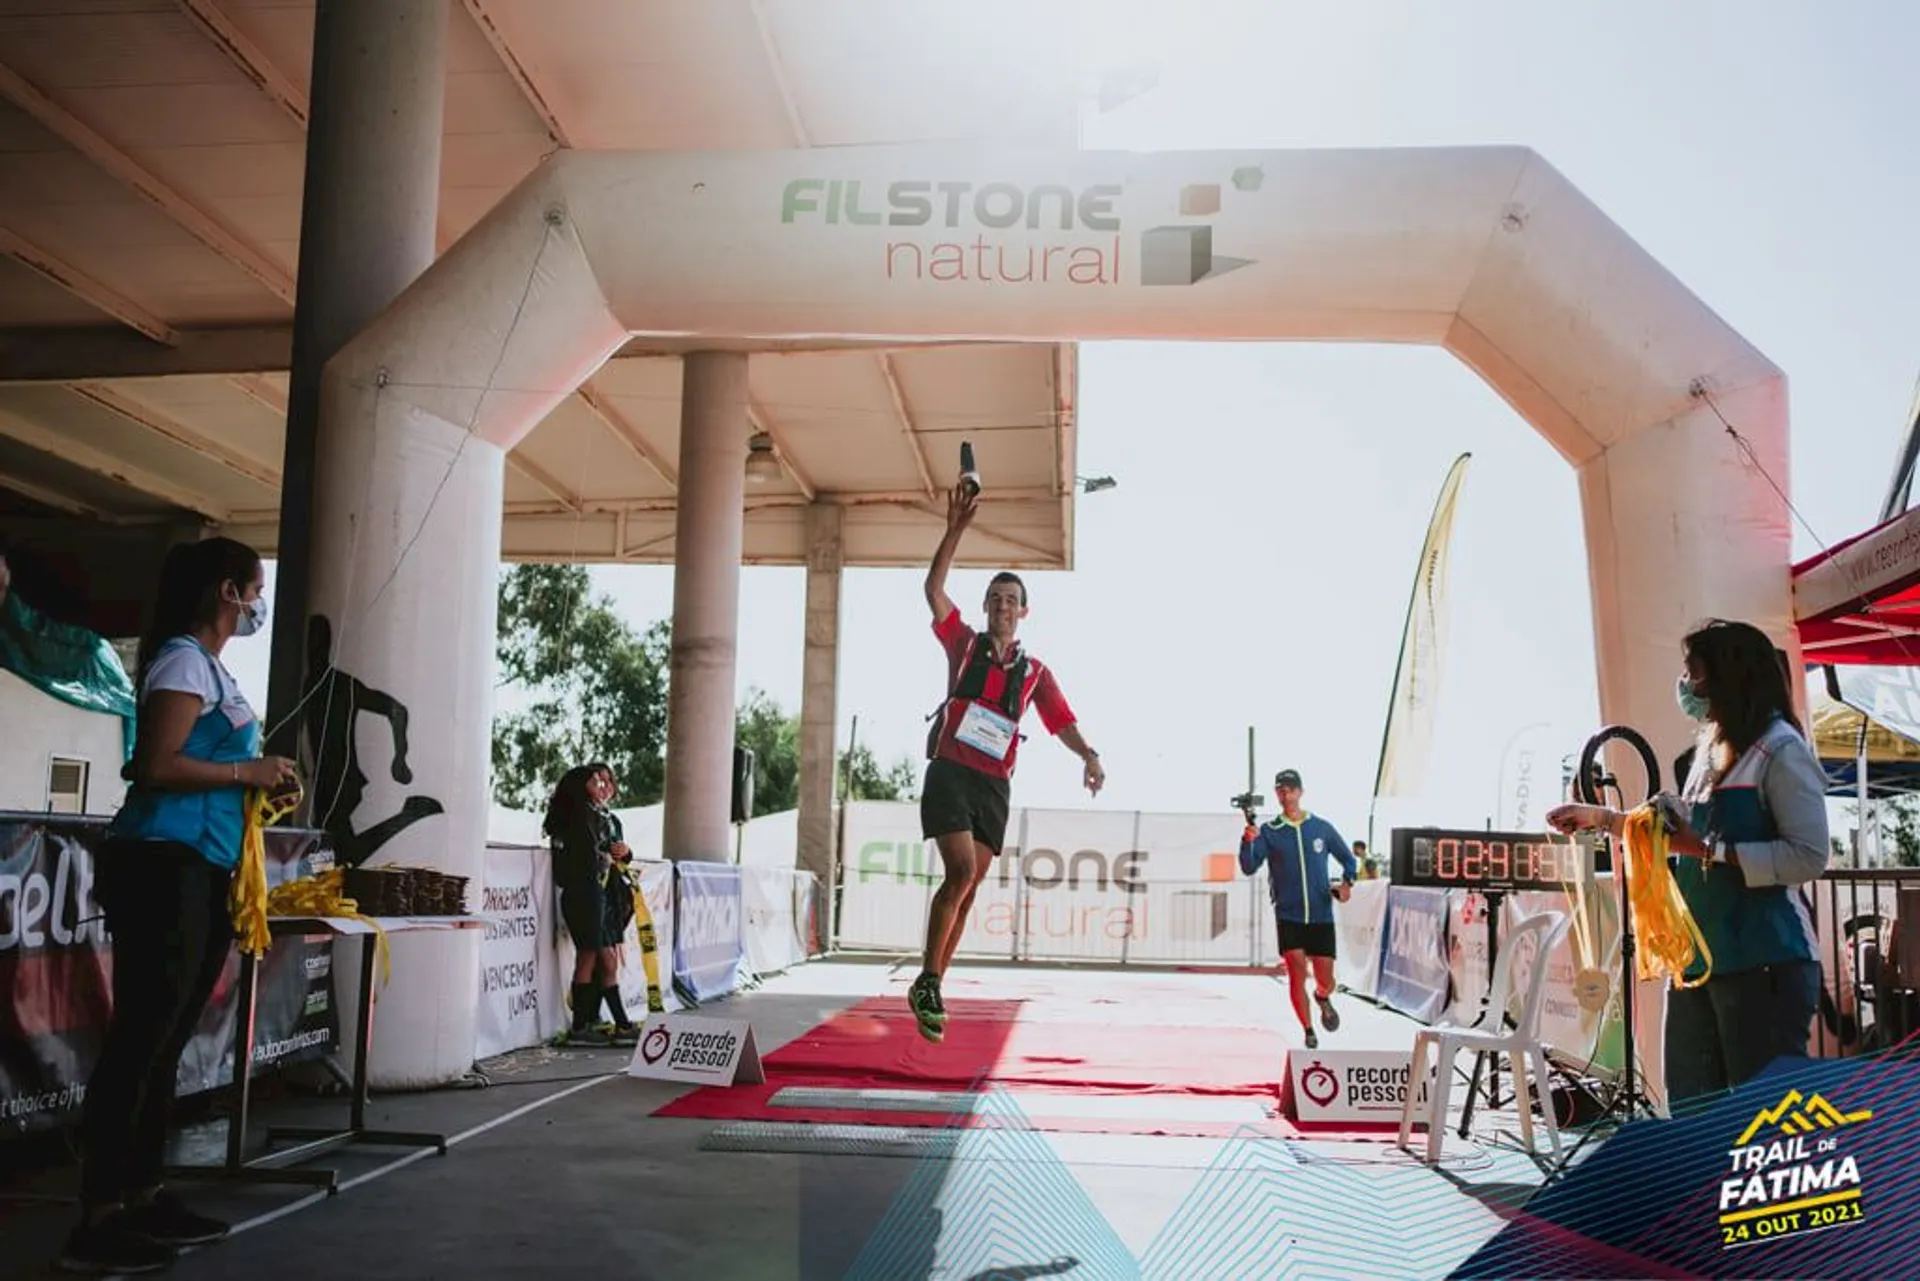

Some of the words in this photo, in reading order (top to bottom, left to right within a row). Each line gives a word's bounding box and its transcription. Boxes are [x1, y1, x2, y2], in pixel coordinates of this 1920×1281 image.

[781, 178, 1123, 231] FILSTONE
[886, 232, 1120, 285] natural
[858, 840, 1149, 894] FILTONE
[677, 1029, 736, 1051] recorde
[668, 1047, 736, 1067] pessoal
[1347, 1063, 1411, 1084] record
[1348, 1081, 1428, 1106] pessol
